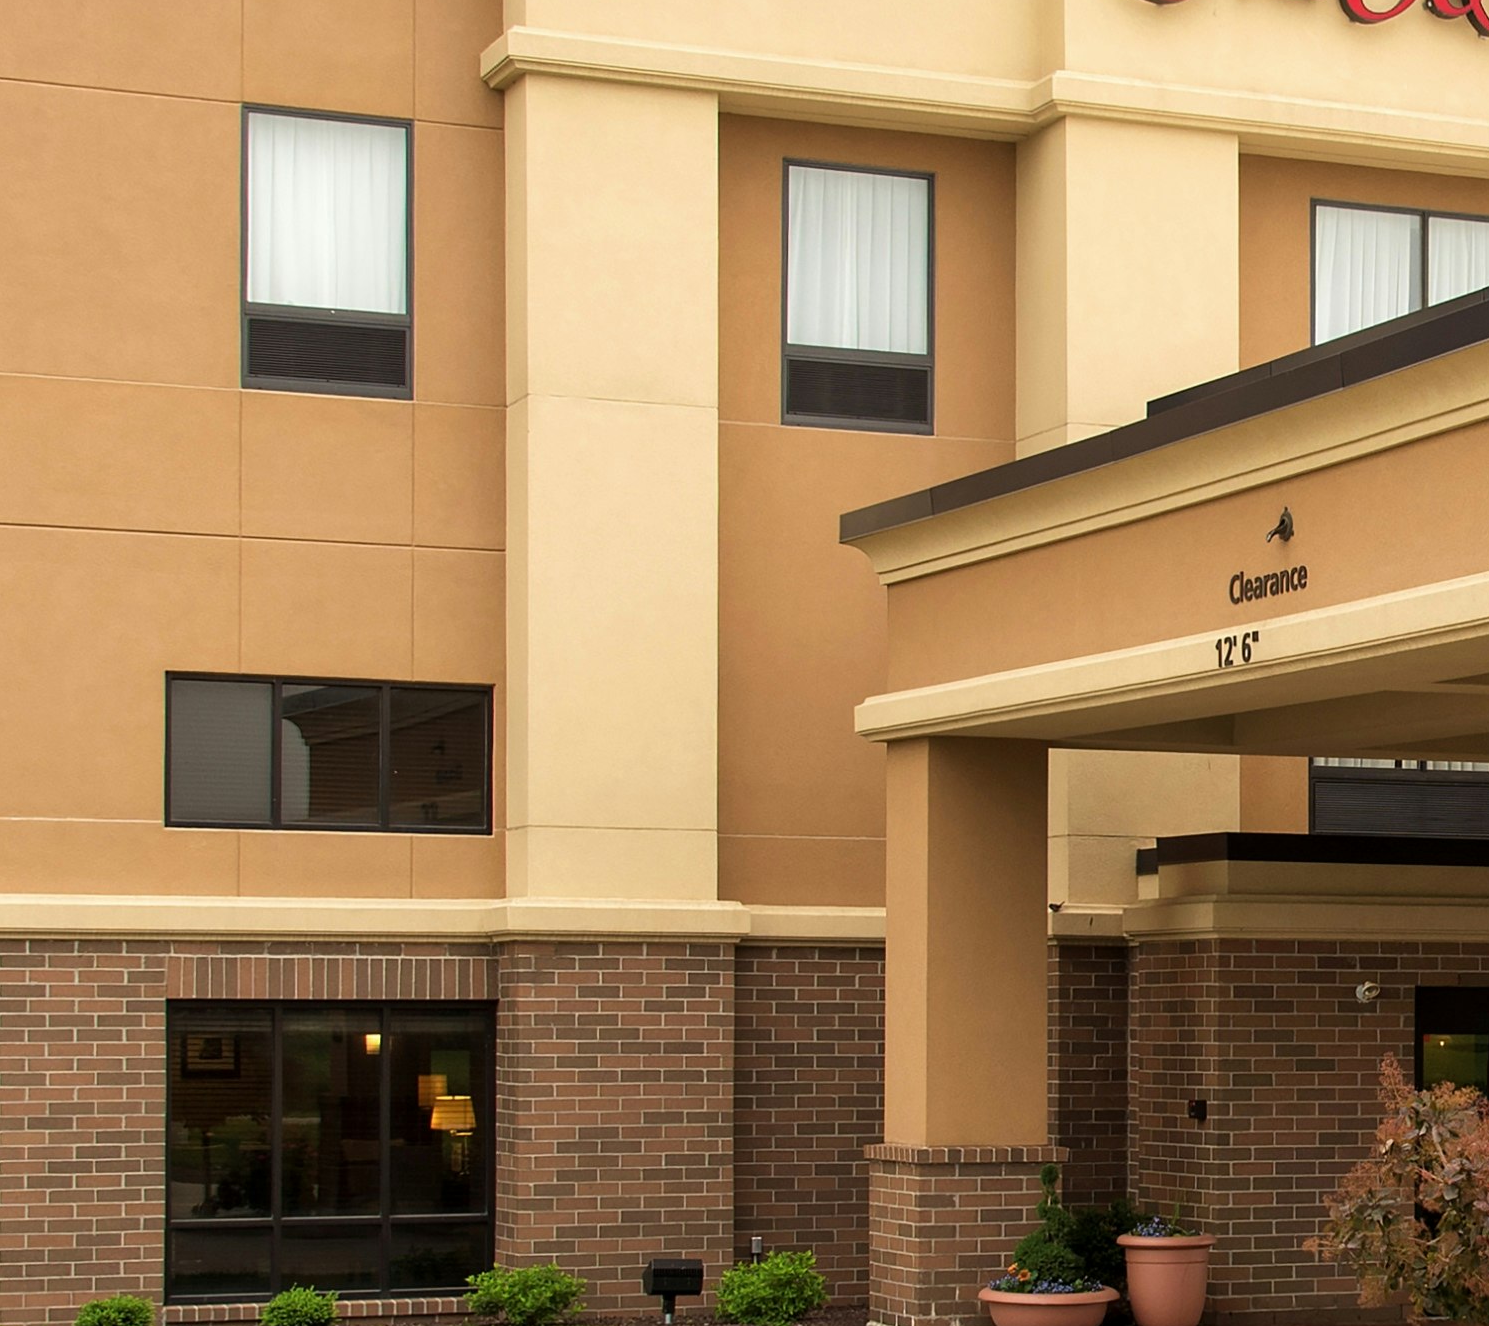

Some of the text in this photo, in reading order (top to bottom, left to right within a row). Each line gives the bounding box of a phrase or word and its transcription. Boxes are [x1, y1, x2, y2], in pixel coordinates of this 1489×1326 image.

[1229, 564, 1308, 605] Clearance
[1215, 630, 1260, 668] 12' 6"
